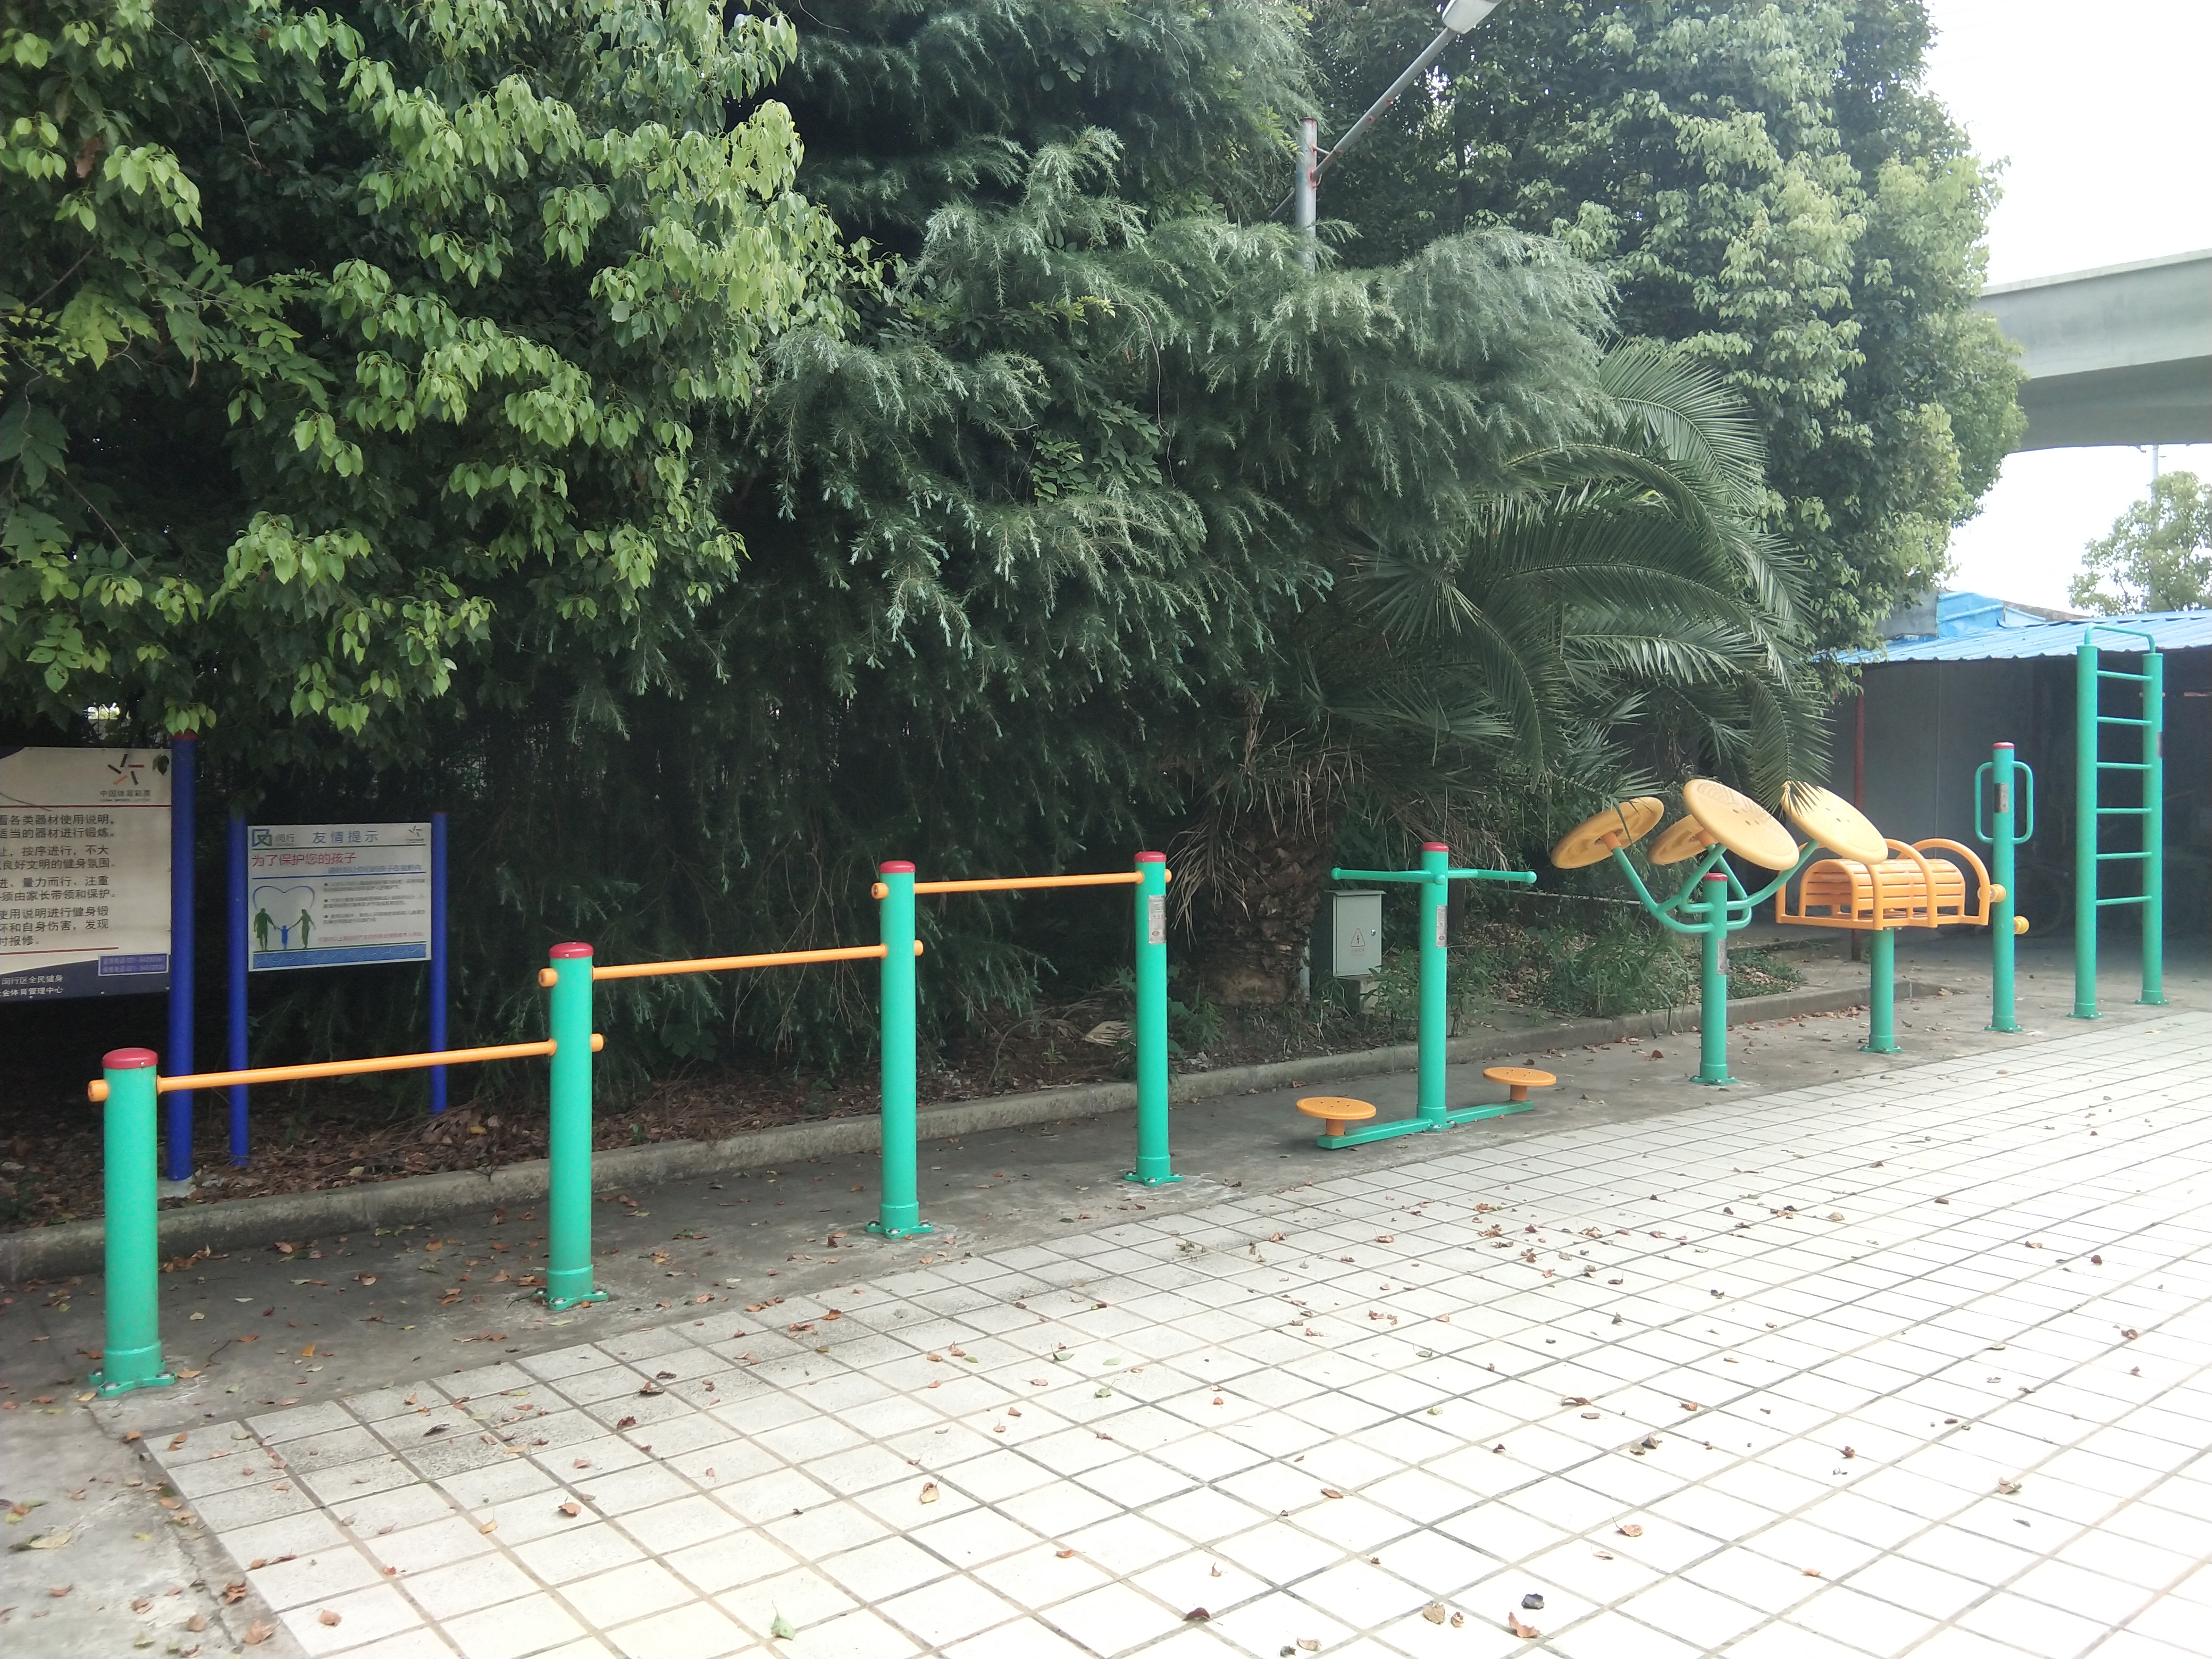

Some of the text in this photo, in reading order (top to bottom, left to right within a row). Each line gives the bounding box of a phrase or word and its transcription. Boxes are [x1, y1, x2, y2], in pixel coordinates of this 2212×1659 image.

[312, 831, 379, 844] 友情提示
[252, 852, 356, 867] 为了保护您的孩子
